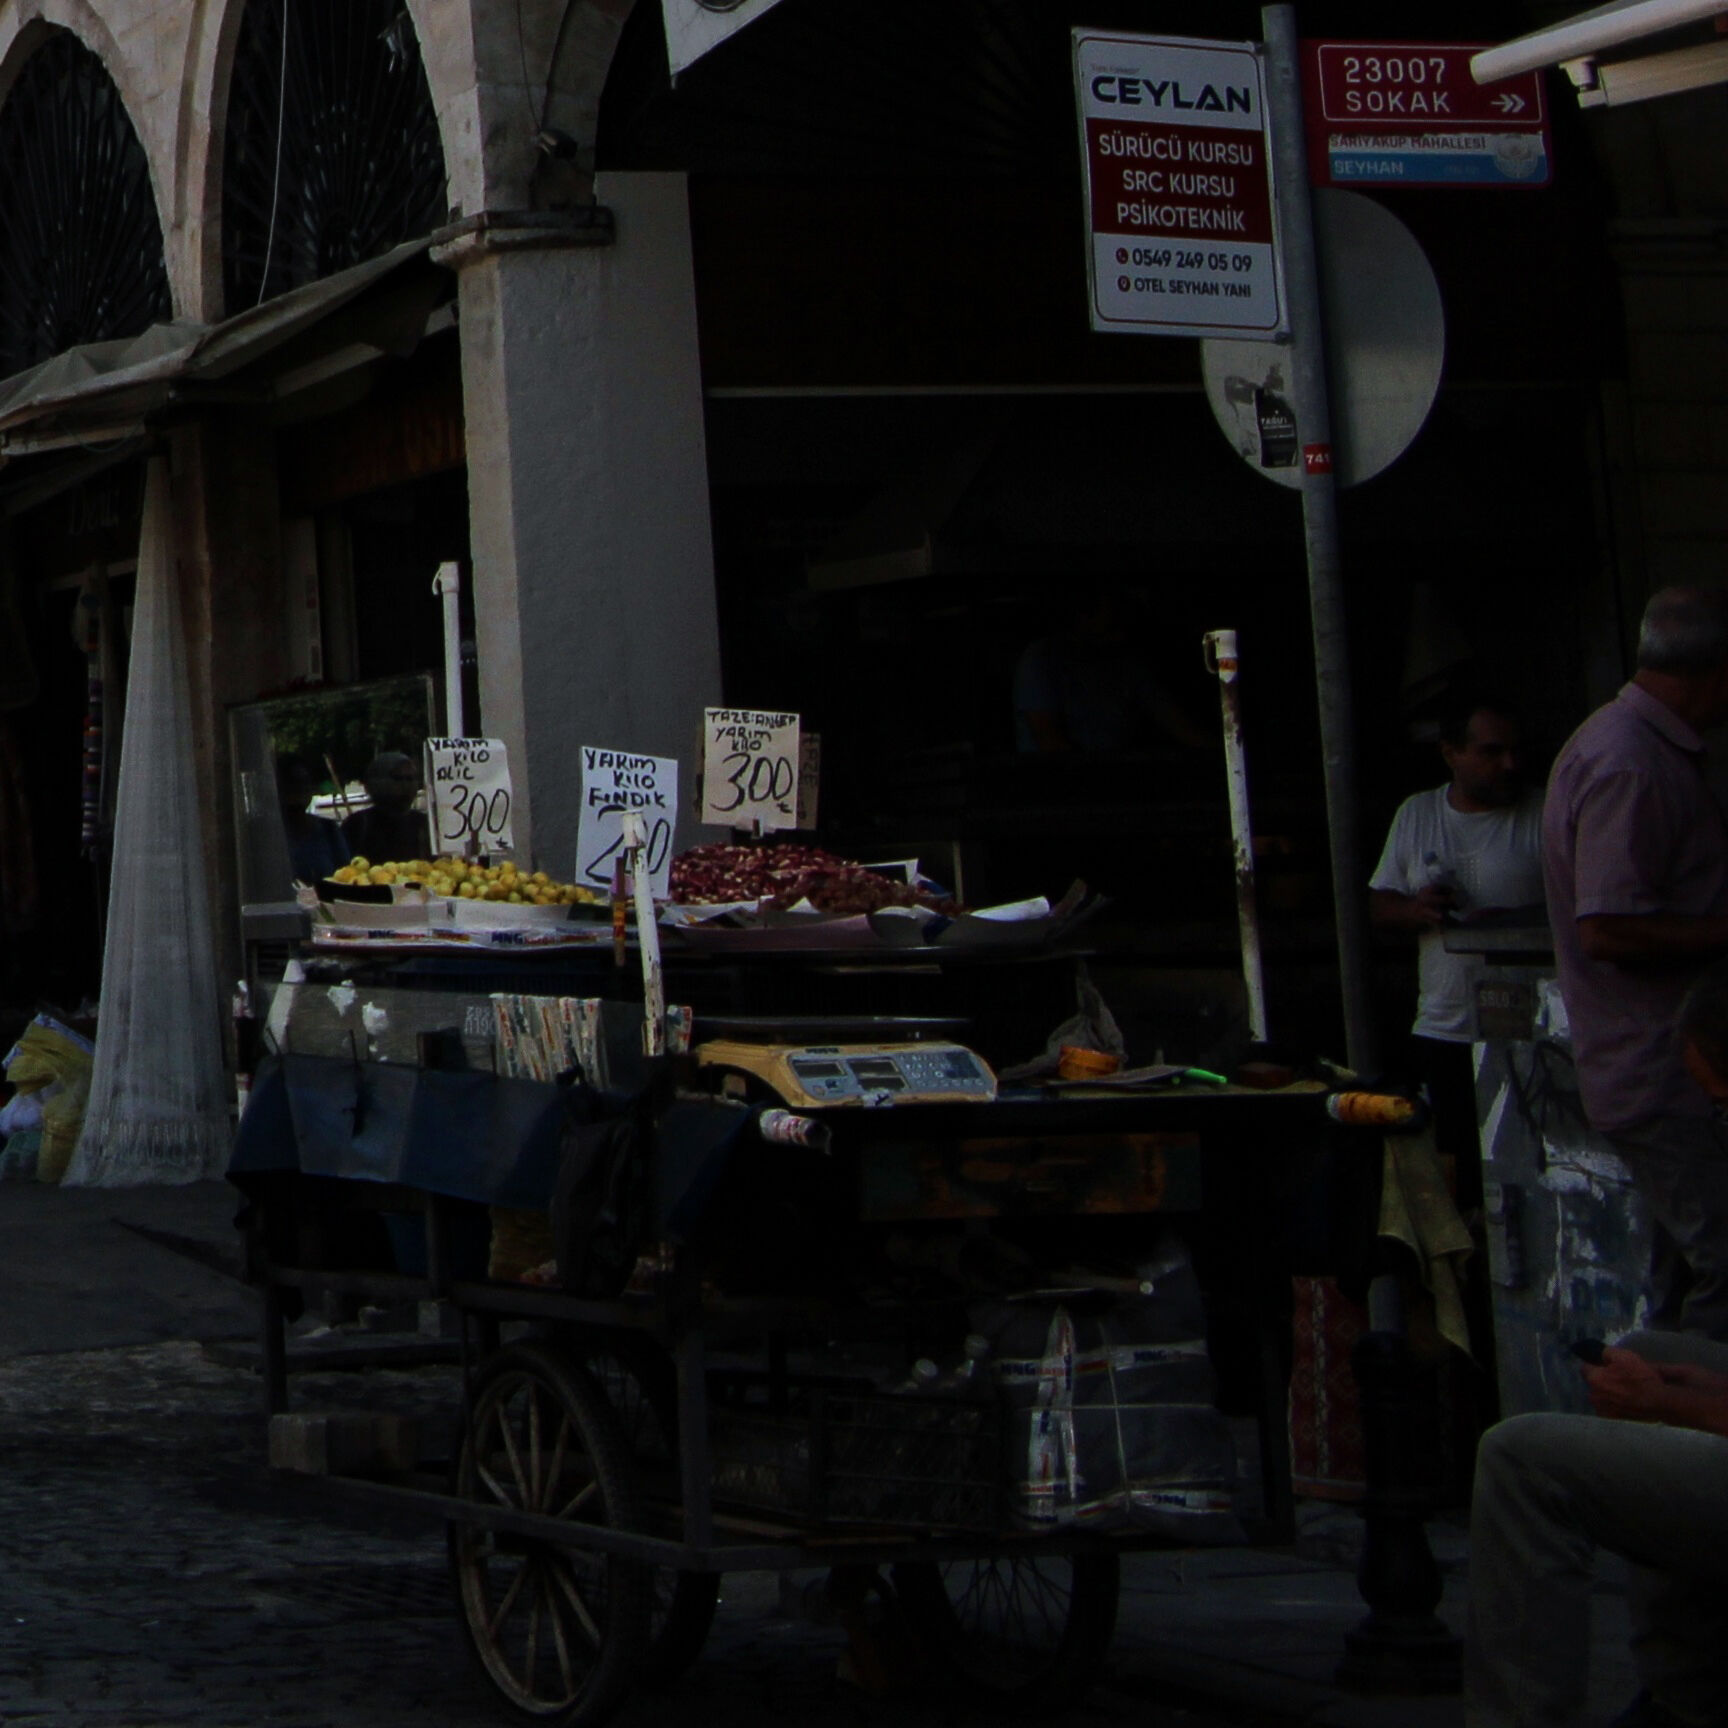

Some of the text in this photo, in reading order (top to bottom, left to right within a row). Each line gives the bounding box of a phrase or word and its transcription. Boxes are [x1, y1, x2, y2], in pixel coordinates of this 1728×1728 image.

[1344, 57, 1446, 84] 23007
[1092, 76, 1251, 114] CEYLAN
[1345, 90, 1451, 113] SOKAK
[1099, 130, 1253, 166] SÜRÜCÜ KURSU
[1334, 160, 1404, 176] SEYHAN
[1122, 169, 1235, 198] SRC KURSU
[1117, 198, 1247, 232] PSİKOTEKNİK
[1132, 248, 1252, 272] 0549 249 05 09
[1134, 277, 1252, 298] OTEL SEYHAN YANI
[709, 752, 792, 811] 300
[444, 784, 510, 839] 300
